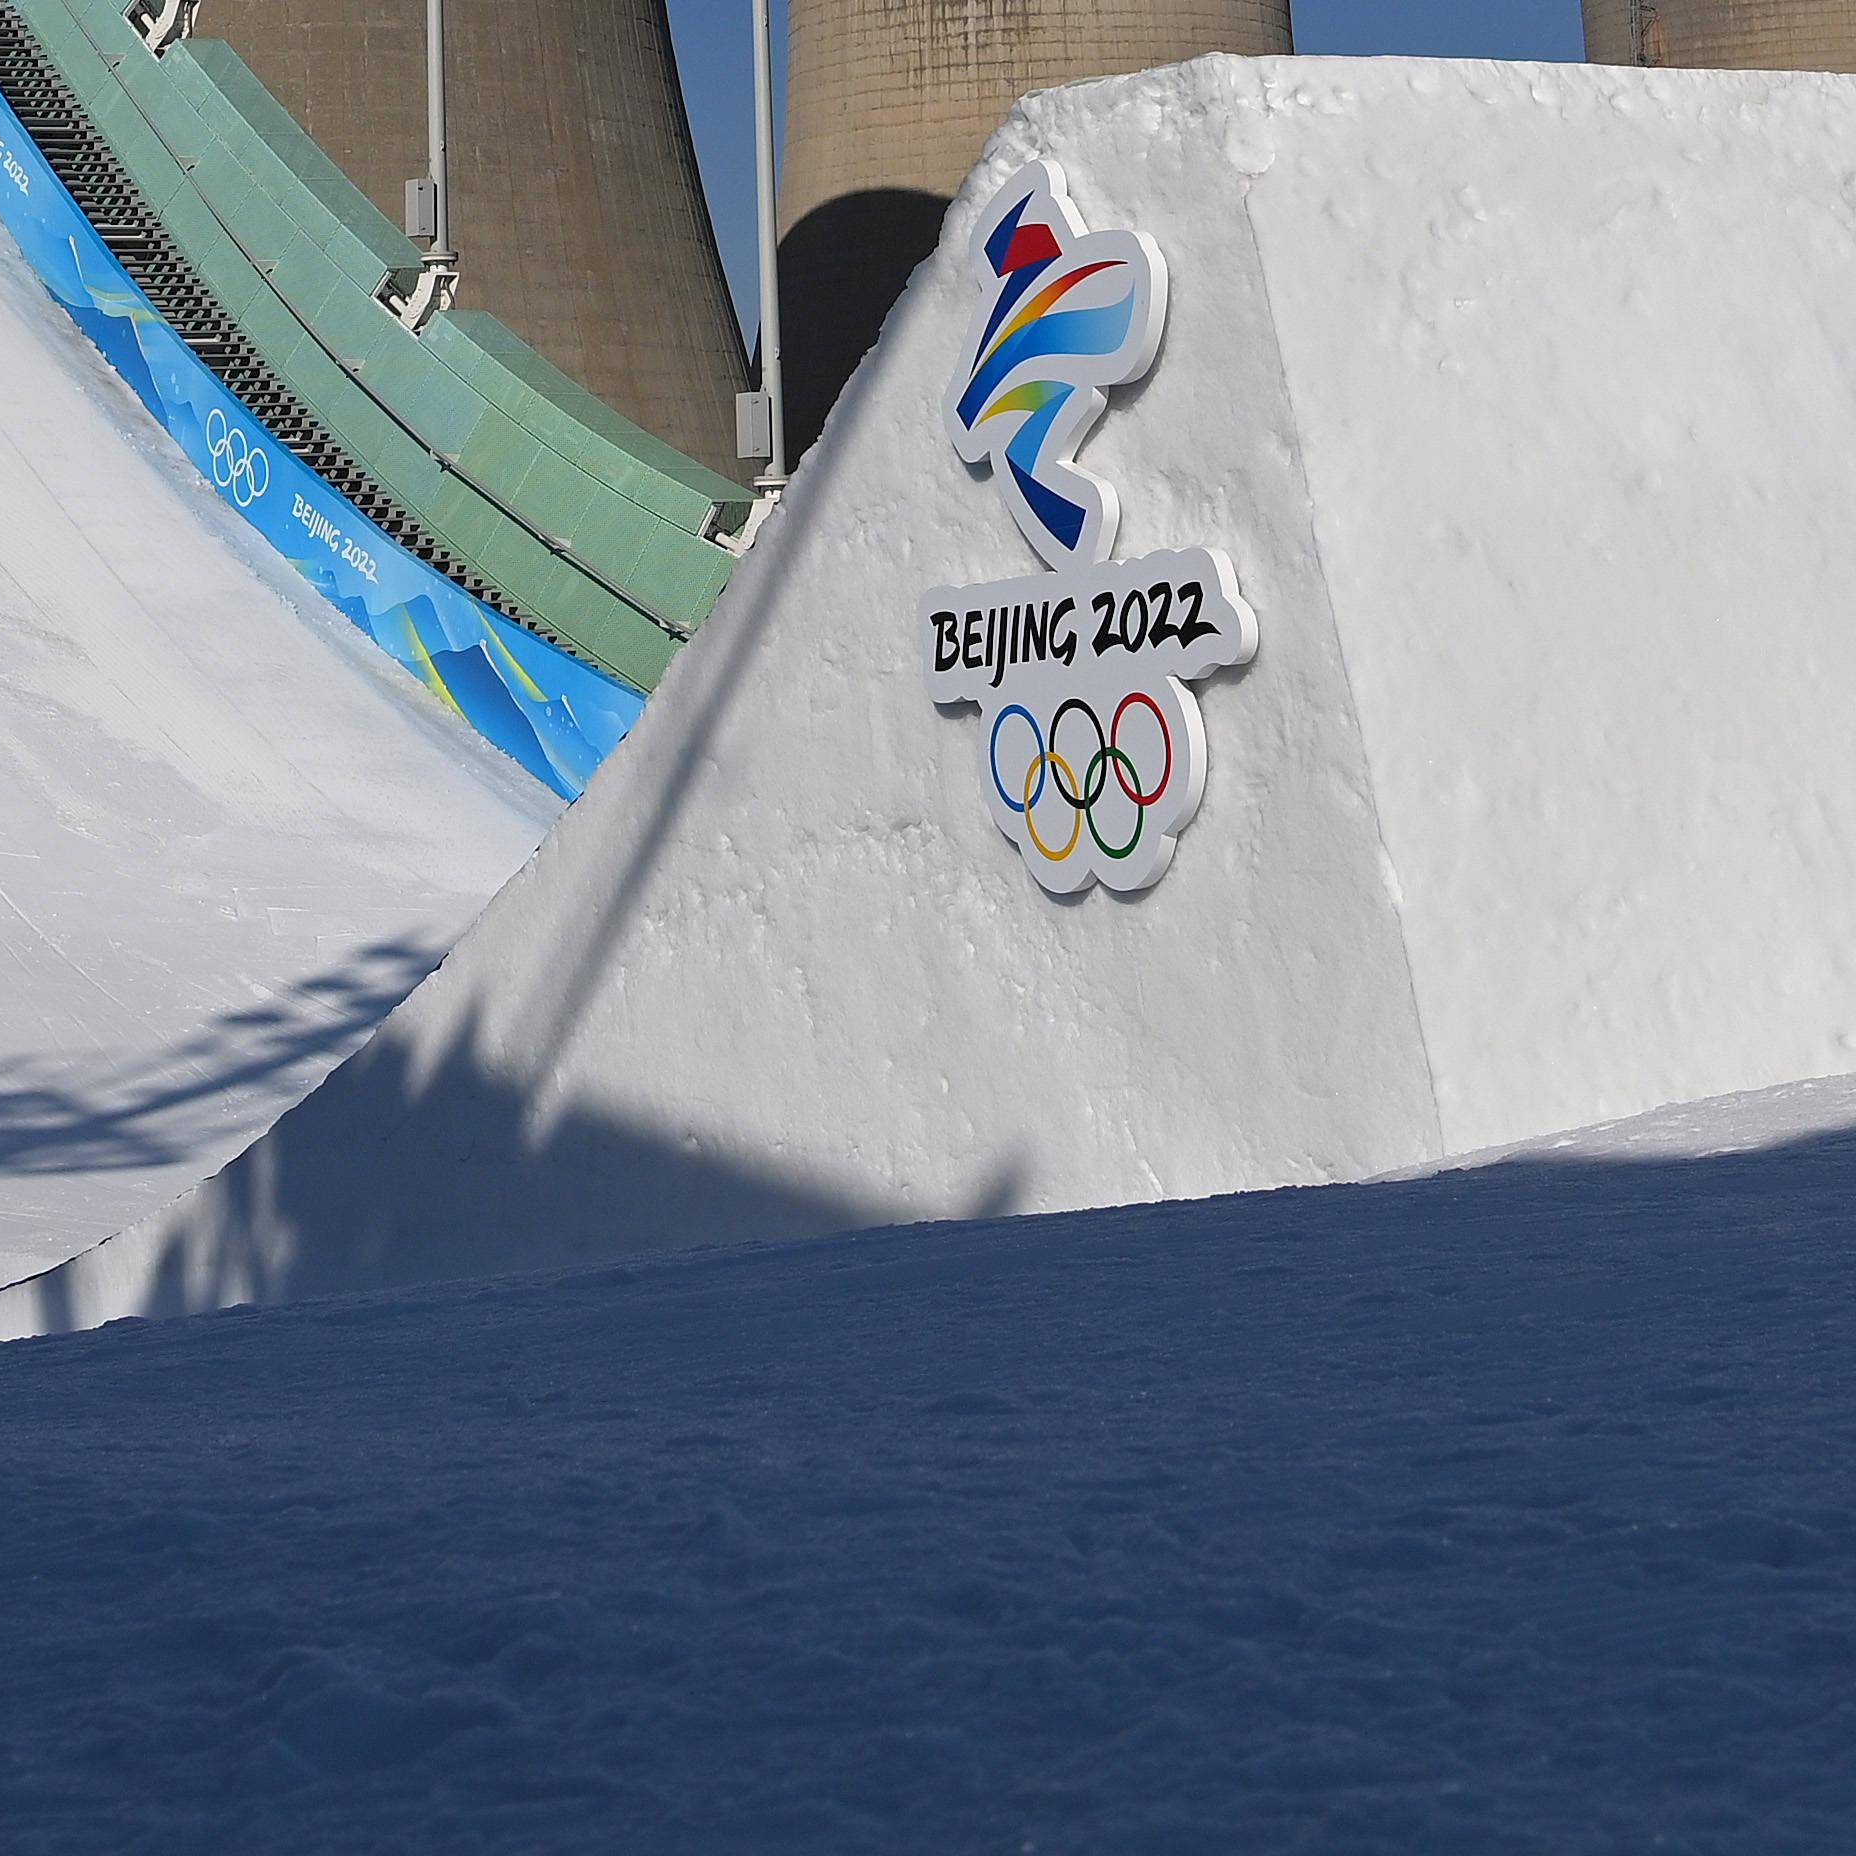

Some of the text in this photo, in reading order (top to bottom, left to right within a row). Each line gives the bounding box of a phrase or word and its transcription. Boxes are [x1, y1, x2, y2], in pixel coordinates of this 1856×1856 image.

[3, 151, 29, 197] 2022
[292, 493, 379, 584] BEIJING 2022
[930, 581, 1221, 688] BEIJING 2022
